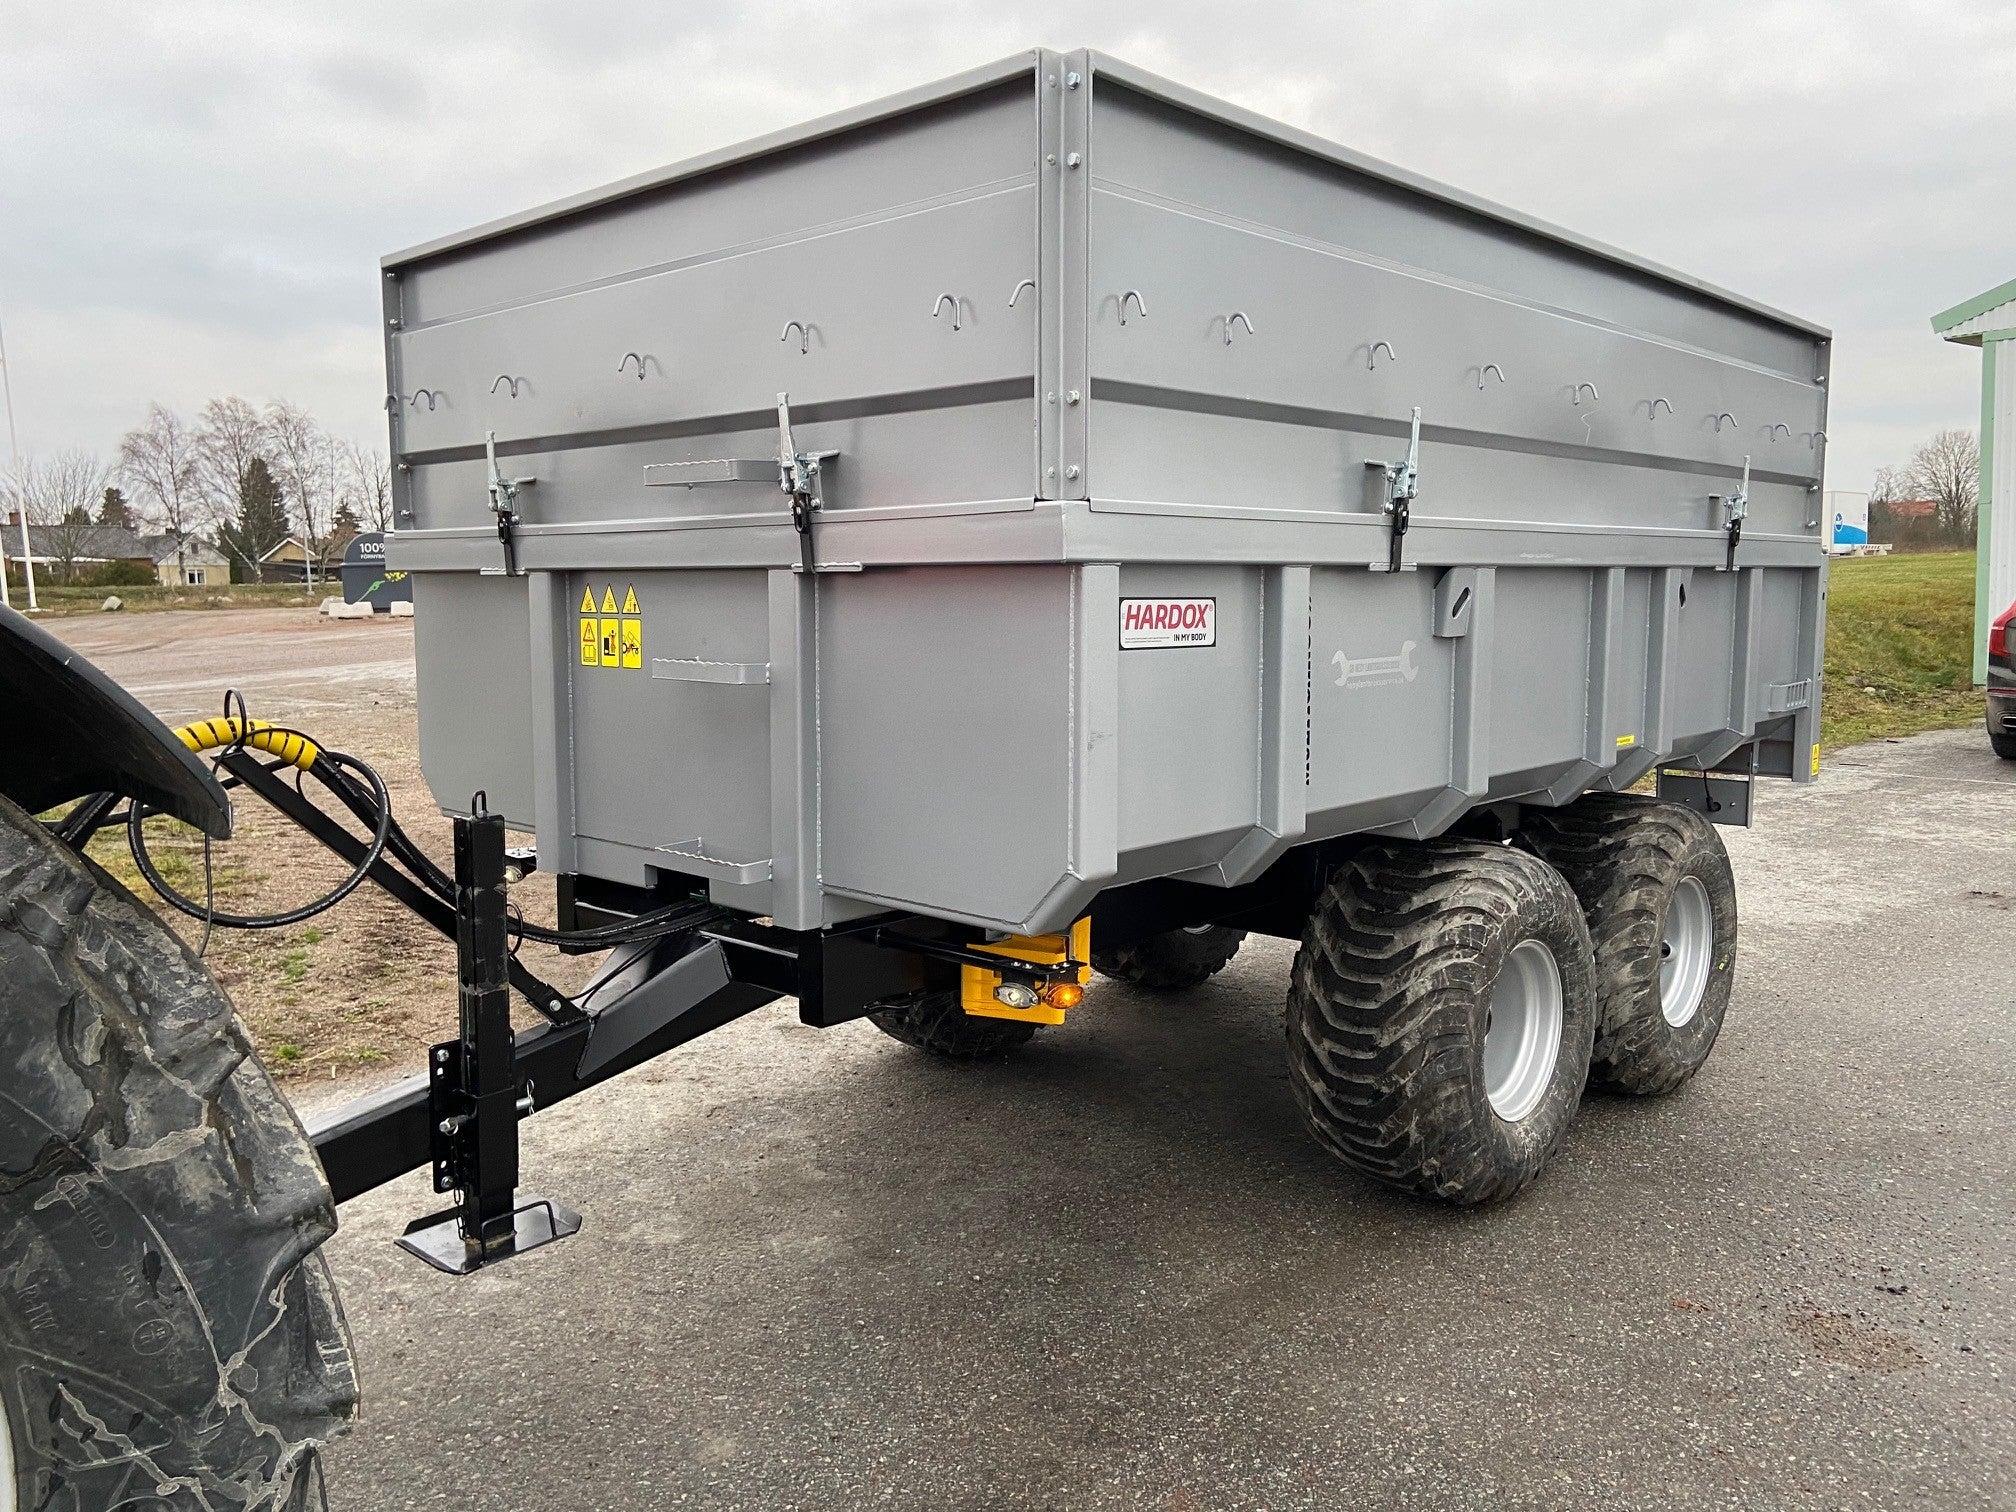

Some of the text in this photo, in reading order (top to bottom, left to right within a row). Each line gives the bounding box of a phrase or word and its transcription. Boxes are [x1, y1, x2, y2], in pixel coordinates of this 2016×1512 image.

[1124, 604, 1208, 630] HARDOX
[1181, 633, 1190, 641] MY
[1191, 633, 1207, 641] BODY
